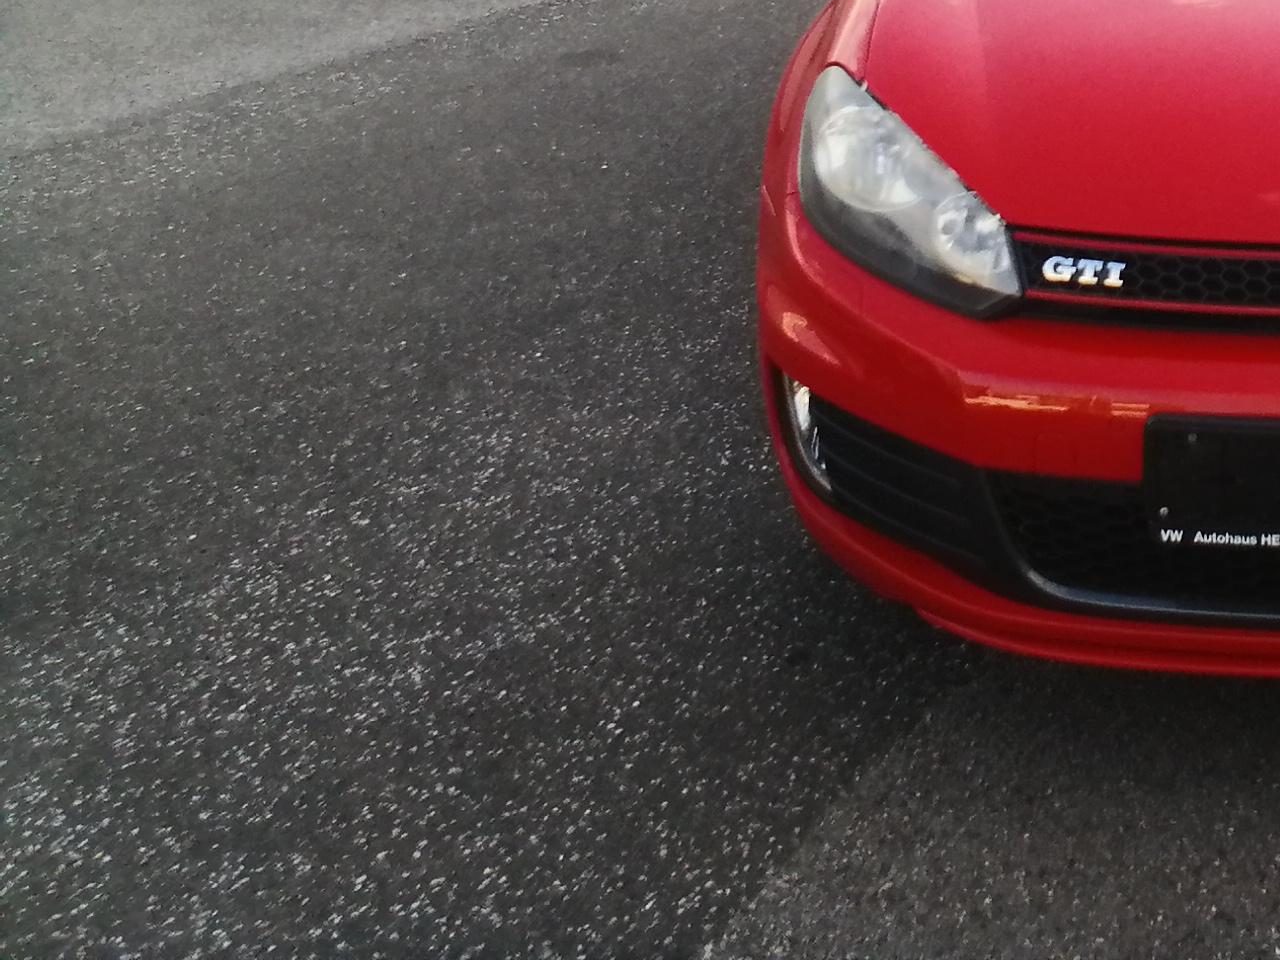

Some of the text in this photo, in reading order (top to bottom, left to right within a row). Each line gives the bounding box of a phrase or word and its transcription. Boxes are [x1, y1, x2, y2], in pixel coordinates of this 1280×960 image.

[1042, 255, 1126, 287] GTI
[1160, 529, 1184, 543] VW
[1194, 531, 1258, 545] Autohaus
